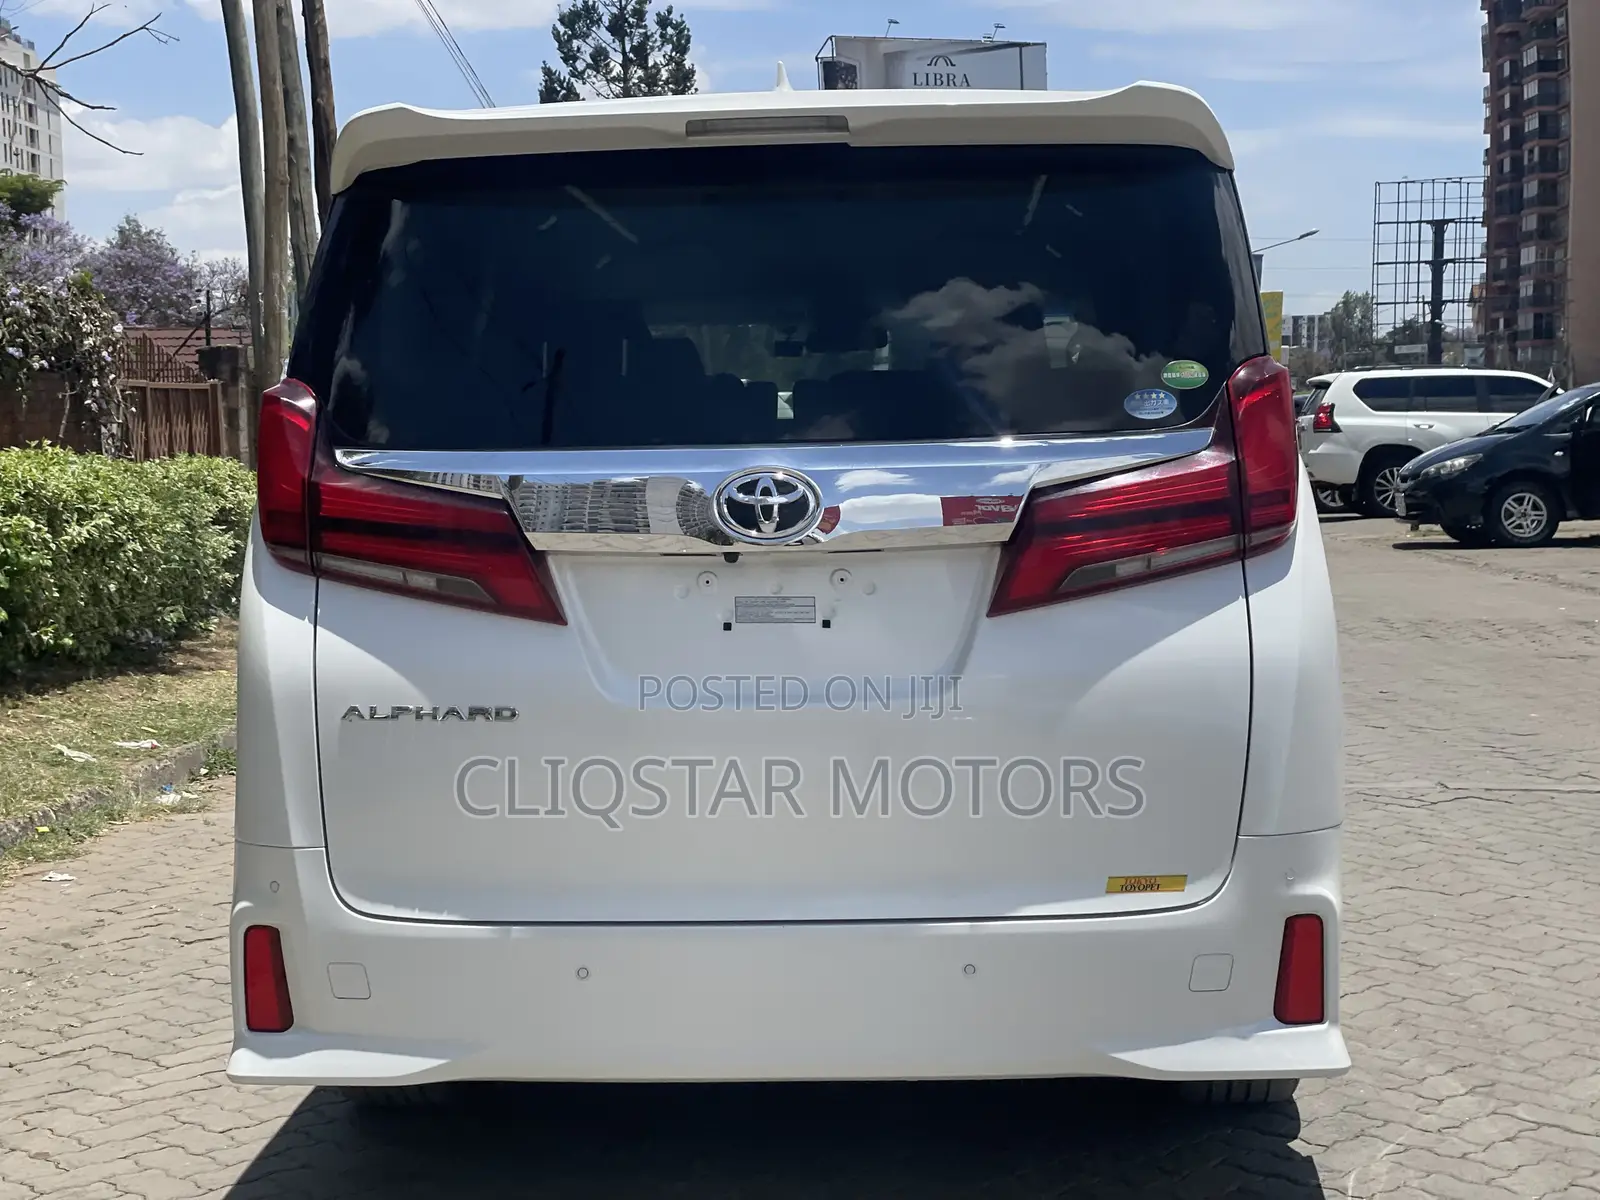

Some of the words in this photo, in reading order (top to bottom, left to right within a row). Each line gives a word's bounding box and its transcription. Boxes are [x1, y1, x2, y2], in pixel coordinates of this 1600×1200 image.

[913, 72, 971, 88] LIBRA
[340, 704, 520, 722] ALPHARD
[1120, 883, 1161, 892] TOYOPET
